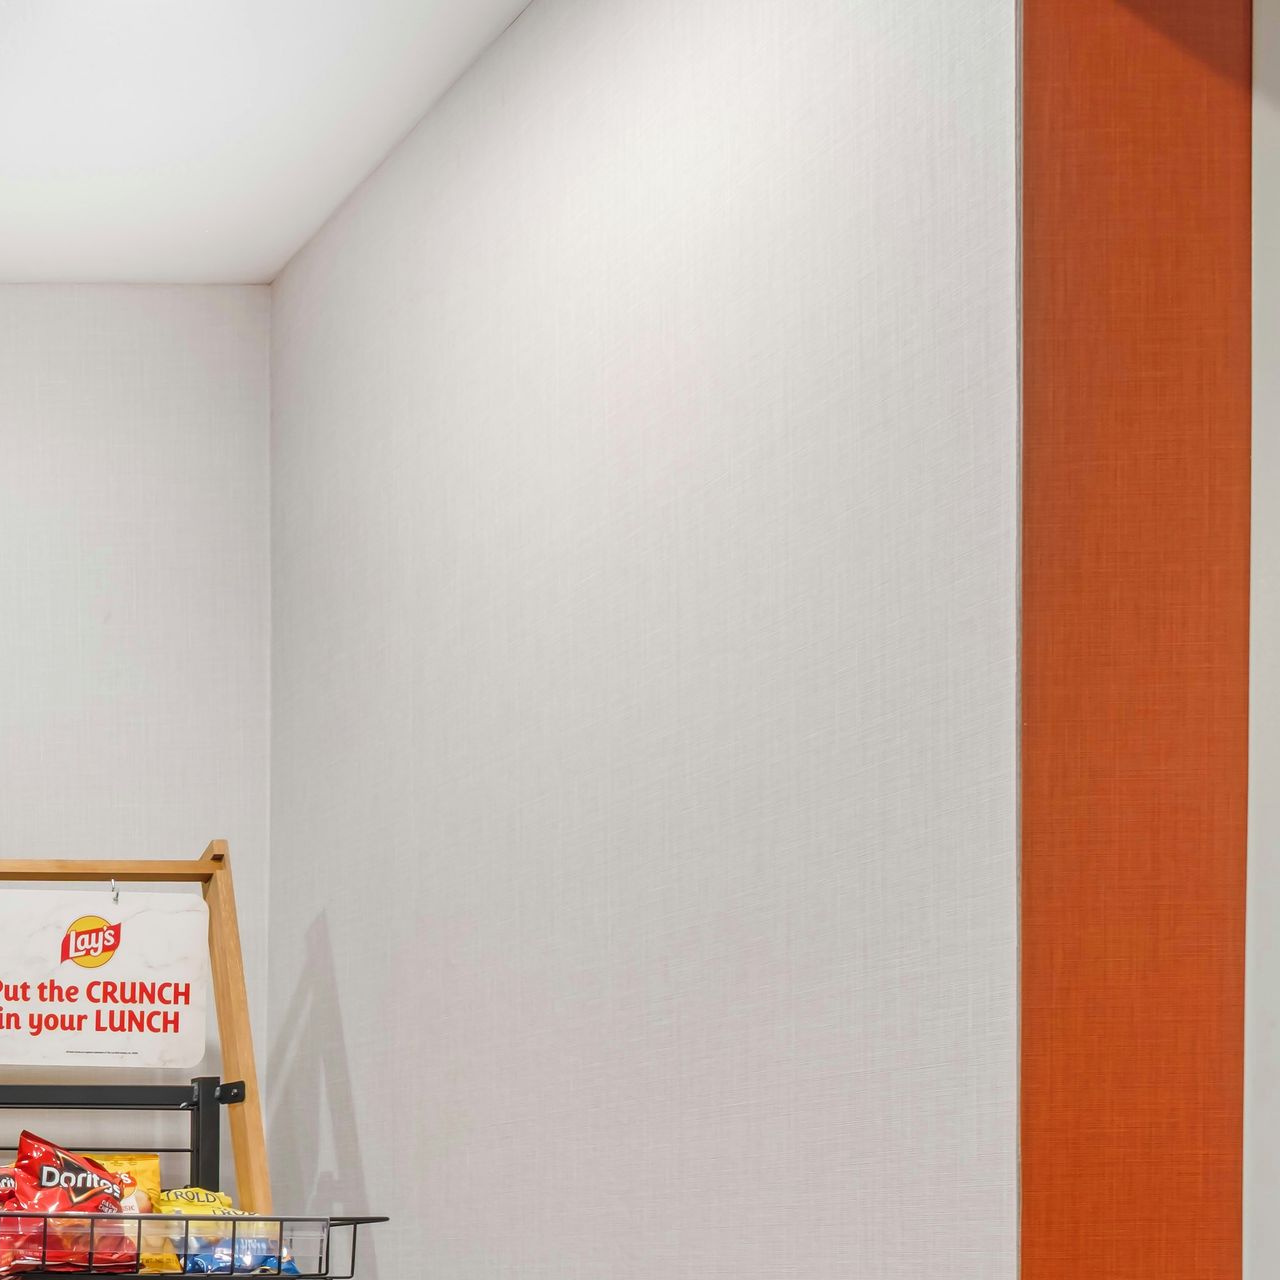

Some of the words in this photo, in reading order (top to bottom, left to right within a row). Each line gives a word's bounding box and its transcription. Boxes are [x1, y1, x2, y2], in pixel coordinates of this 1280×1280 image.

[69, 925, 115, 959] Lay's
[37, 979, 80, 1003] the
[85, 980, 191, 1005] CRUNCH
[28, 1012, 88, 1037] your
[94, 1009, 180, 1034] LUNCH
[41, 1165, 121, 1199] Doritos
